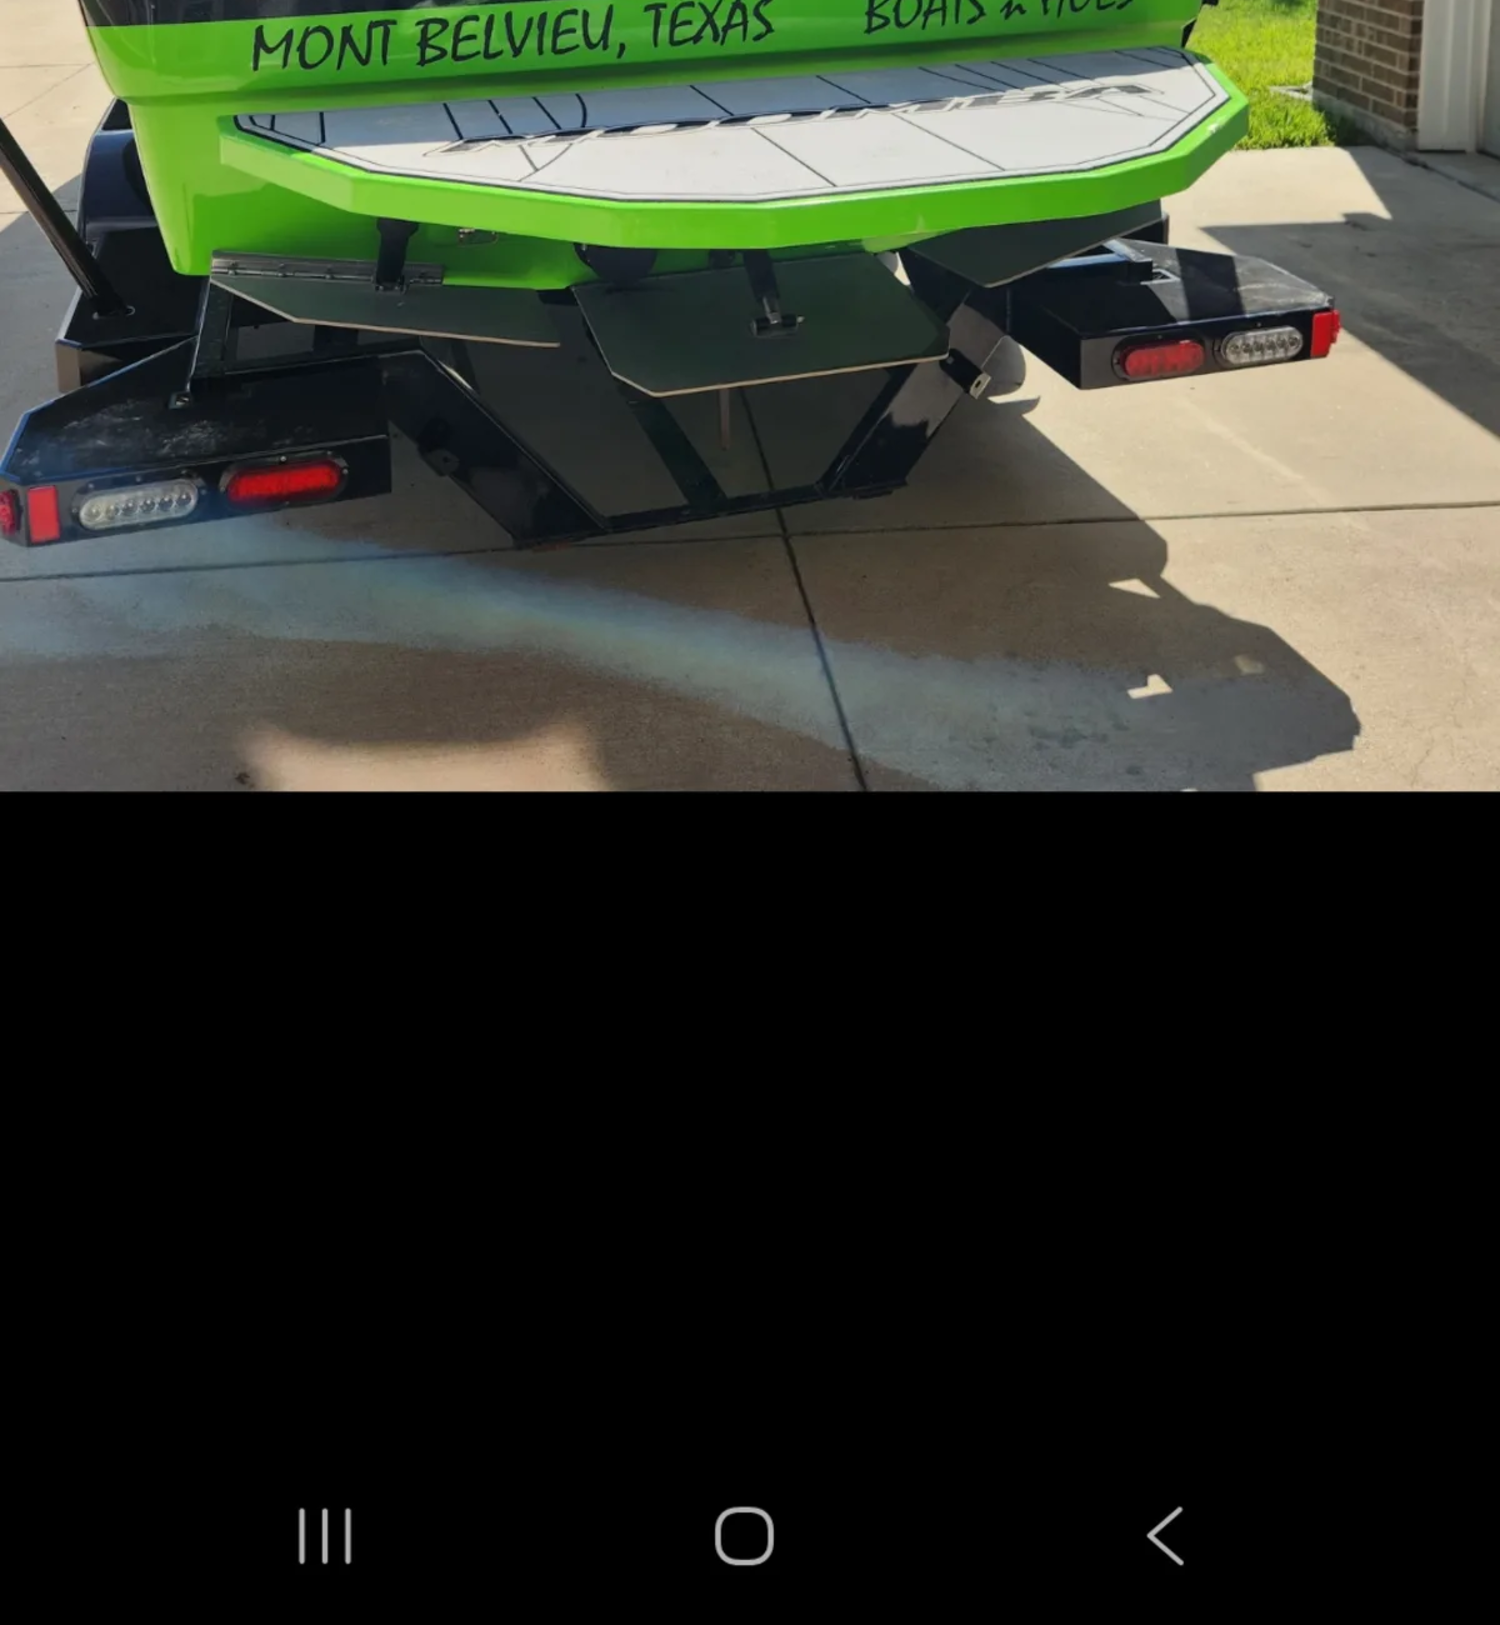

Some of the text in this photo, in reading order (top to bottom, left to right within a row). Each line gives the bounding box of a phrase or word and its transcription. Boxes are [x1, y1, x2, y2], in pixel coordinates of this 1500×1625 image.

[1000, 0, 1026, 21] n
[252, 18, 398, 72] MONT
[416, 3, 626, 67] BELVIEU,
